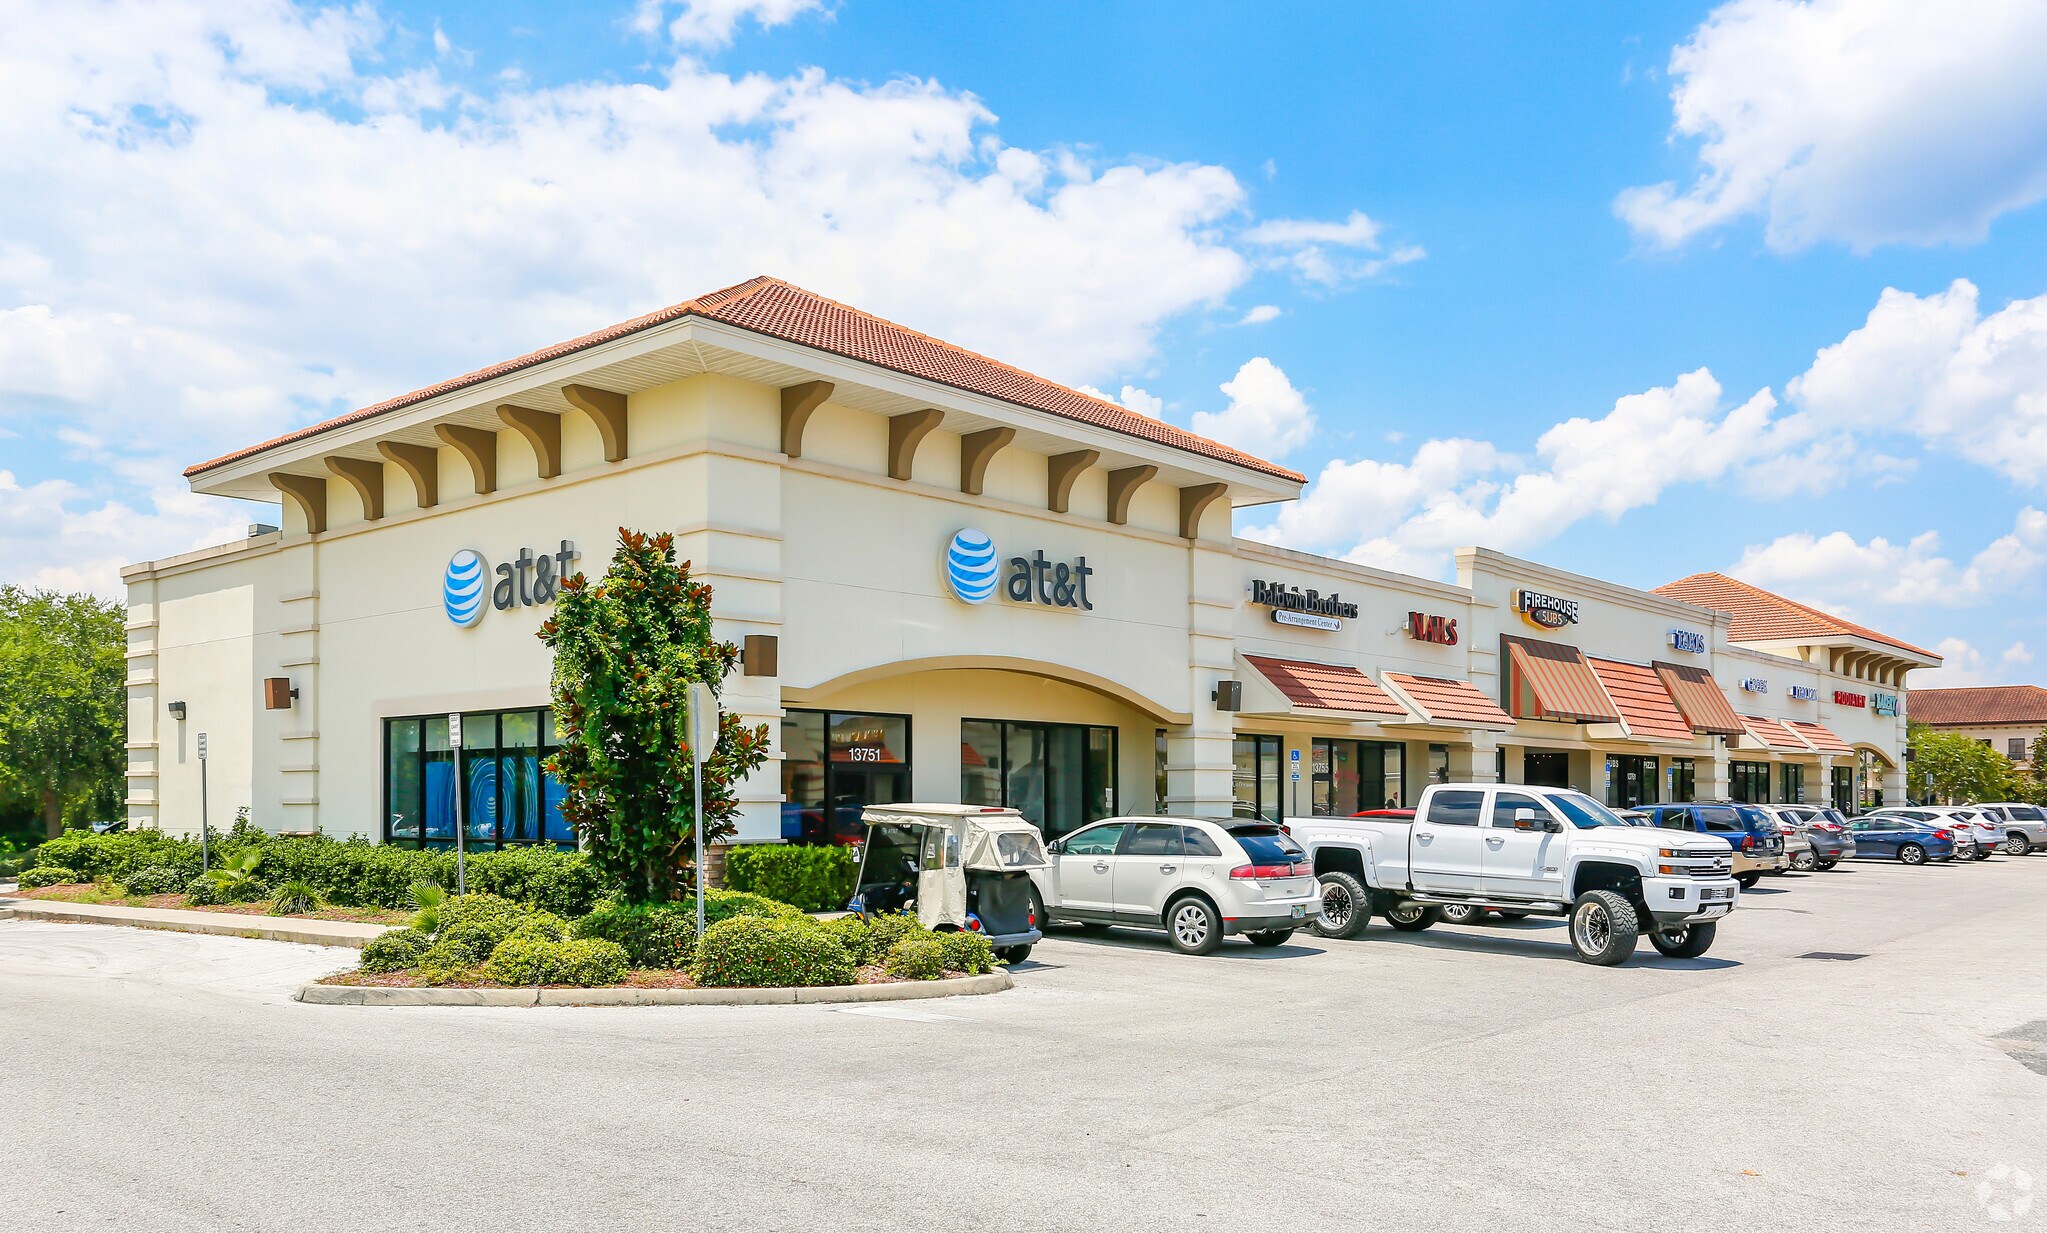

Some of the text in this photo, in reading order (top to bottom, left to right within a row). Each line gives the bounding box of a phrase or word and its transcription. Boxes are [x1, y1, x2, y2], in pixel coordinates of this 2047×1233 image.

[494, 540, 580, 611] at&t
[1004, 549, 1093, 611] at&t
[1252, 580, 1358, 619] Baldwin Brothers
[1524, 591, 1578, 623] FIREHOUSE
[1278, 611, 1333, 628] Pre-Arrangement Center
[1408, 611, 1458, 645] NAILS
[1542, 610, 1563, 625] SUBS
[1836, 691, 1866, 708] PODIATRY
[848, 748, 881, 761] 13751
[1643, 761, 1656, 769] PIZZA
